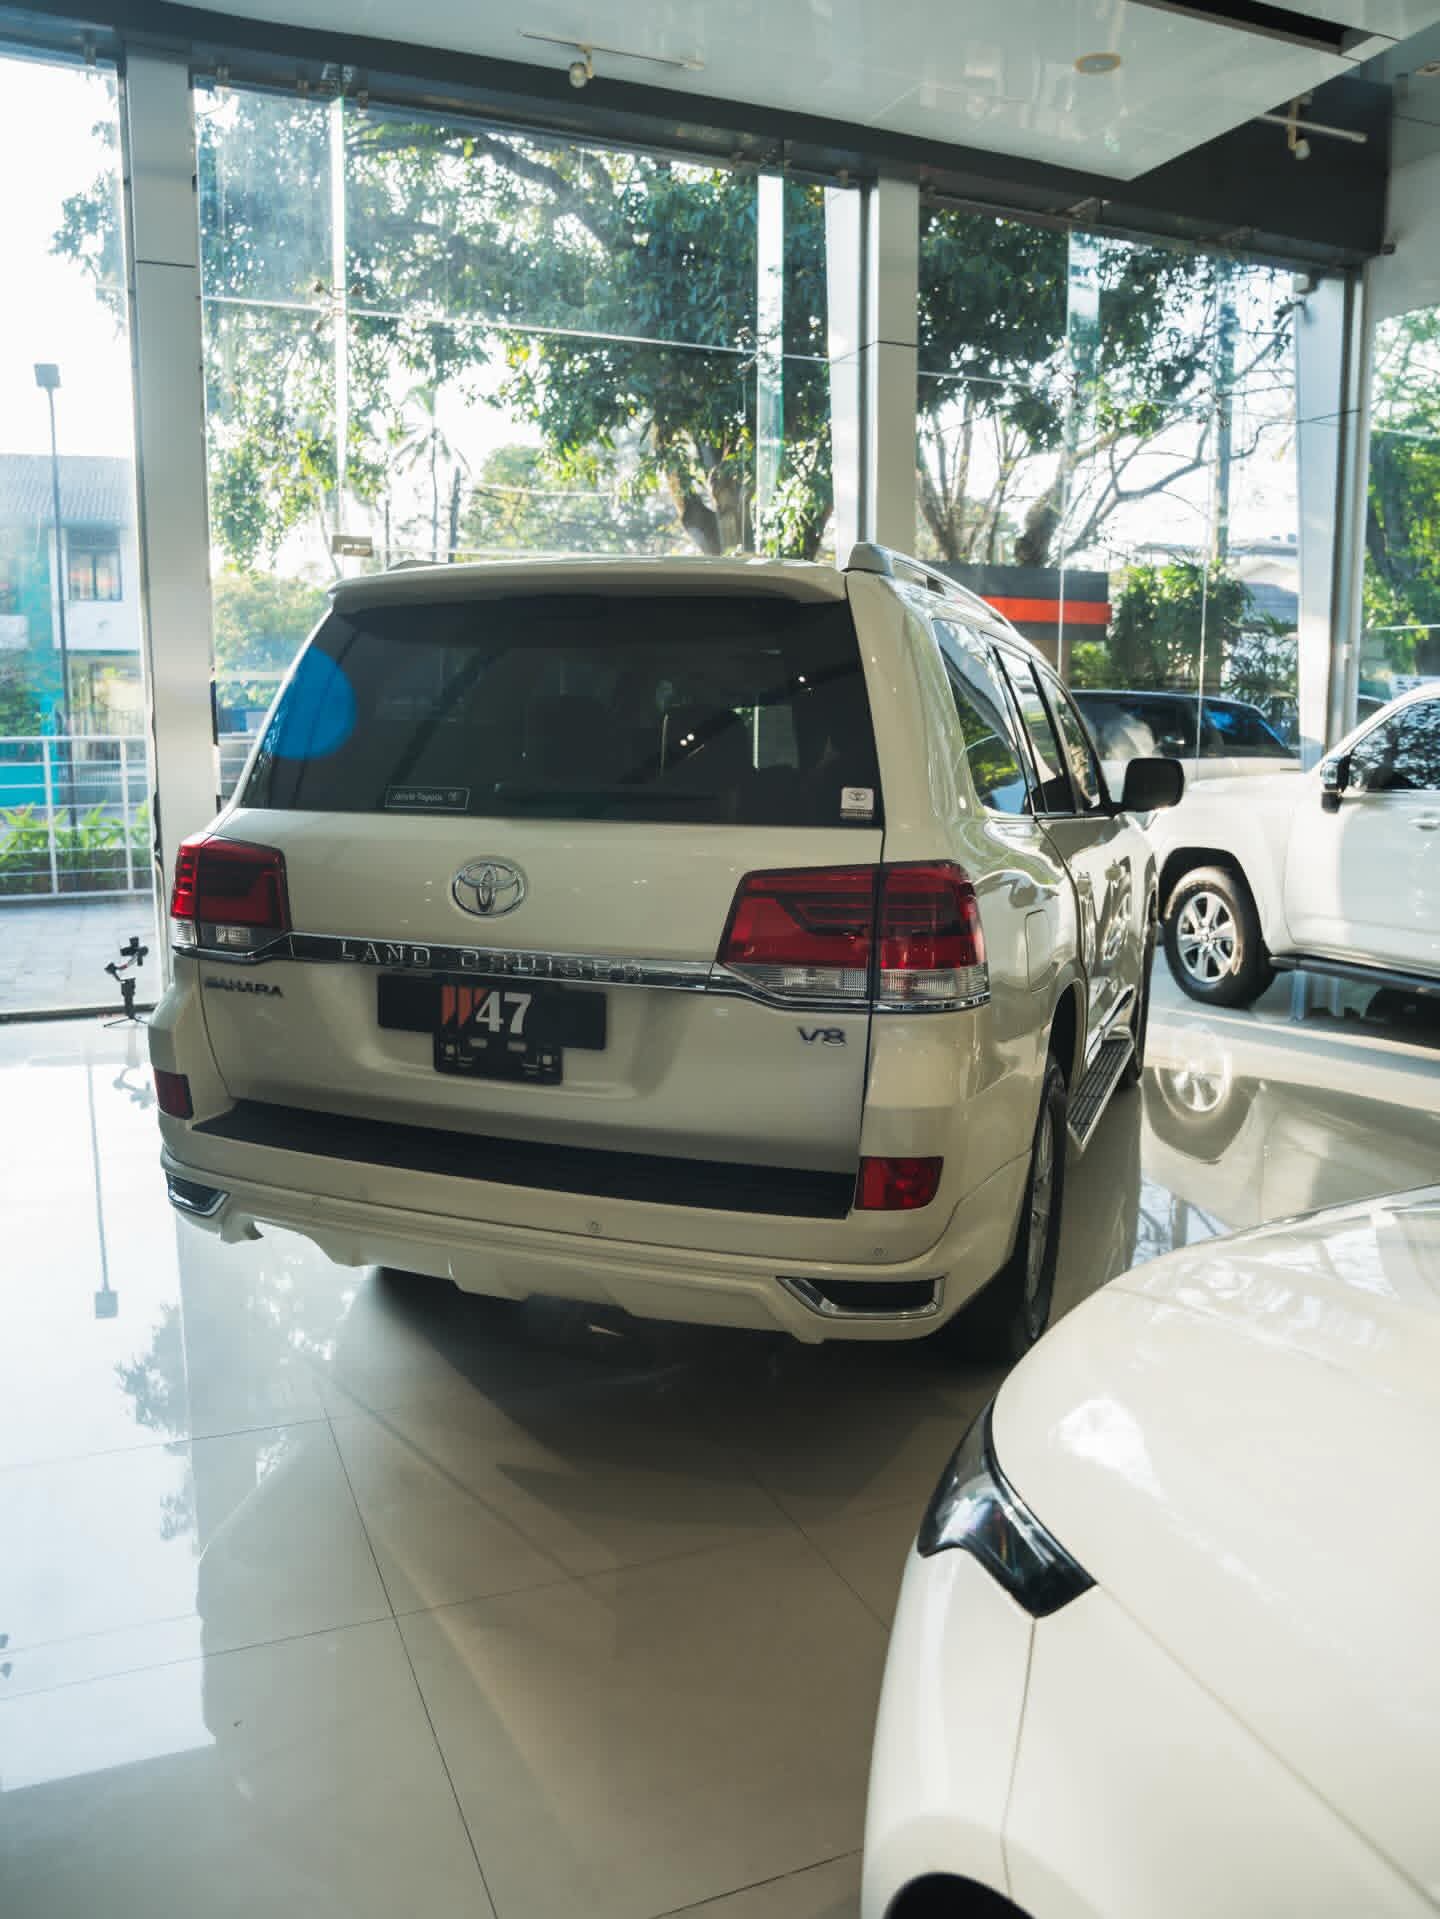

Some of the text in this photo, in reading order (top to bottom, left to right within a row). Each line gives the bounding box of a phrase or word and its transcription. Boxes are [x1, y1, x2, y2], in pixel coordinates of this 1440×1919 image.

[341, 940, 431, 964] LAND
[475, 991, 532, 1034] 47
[797, 1026, 847, 1047] V8
